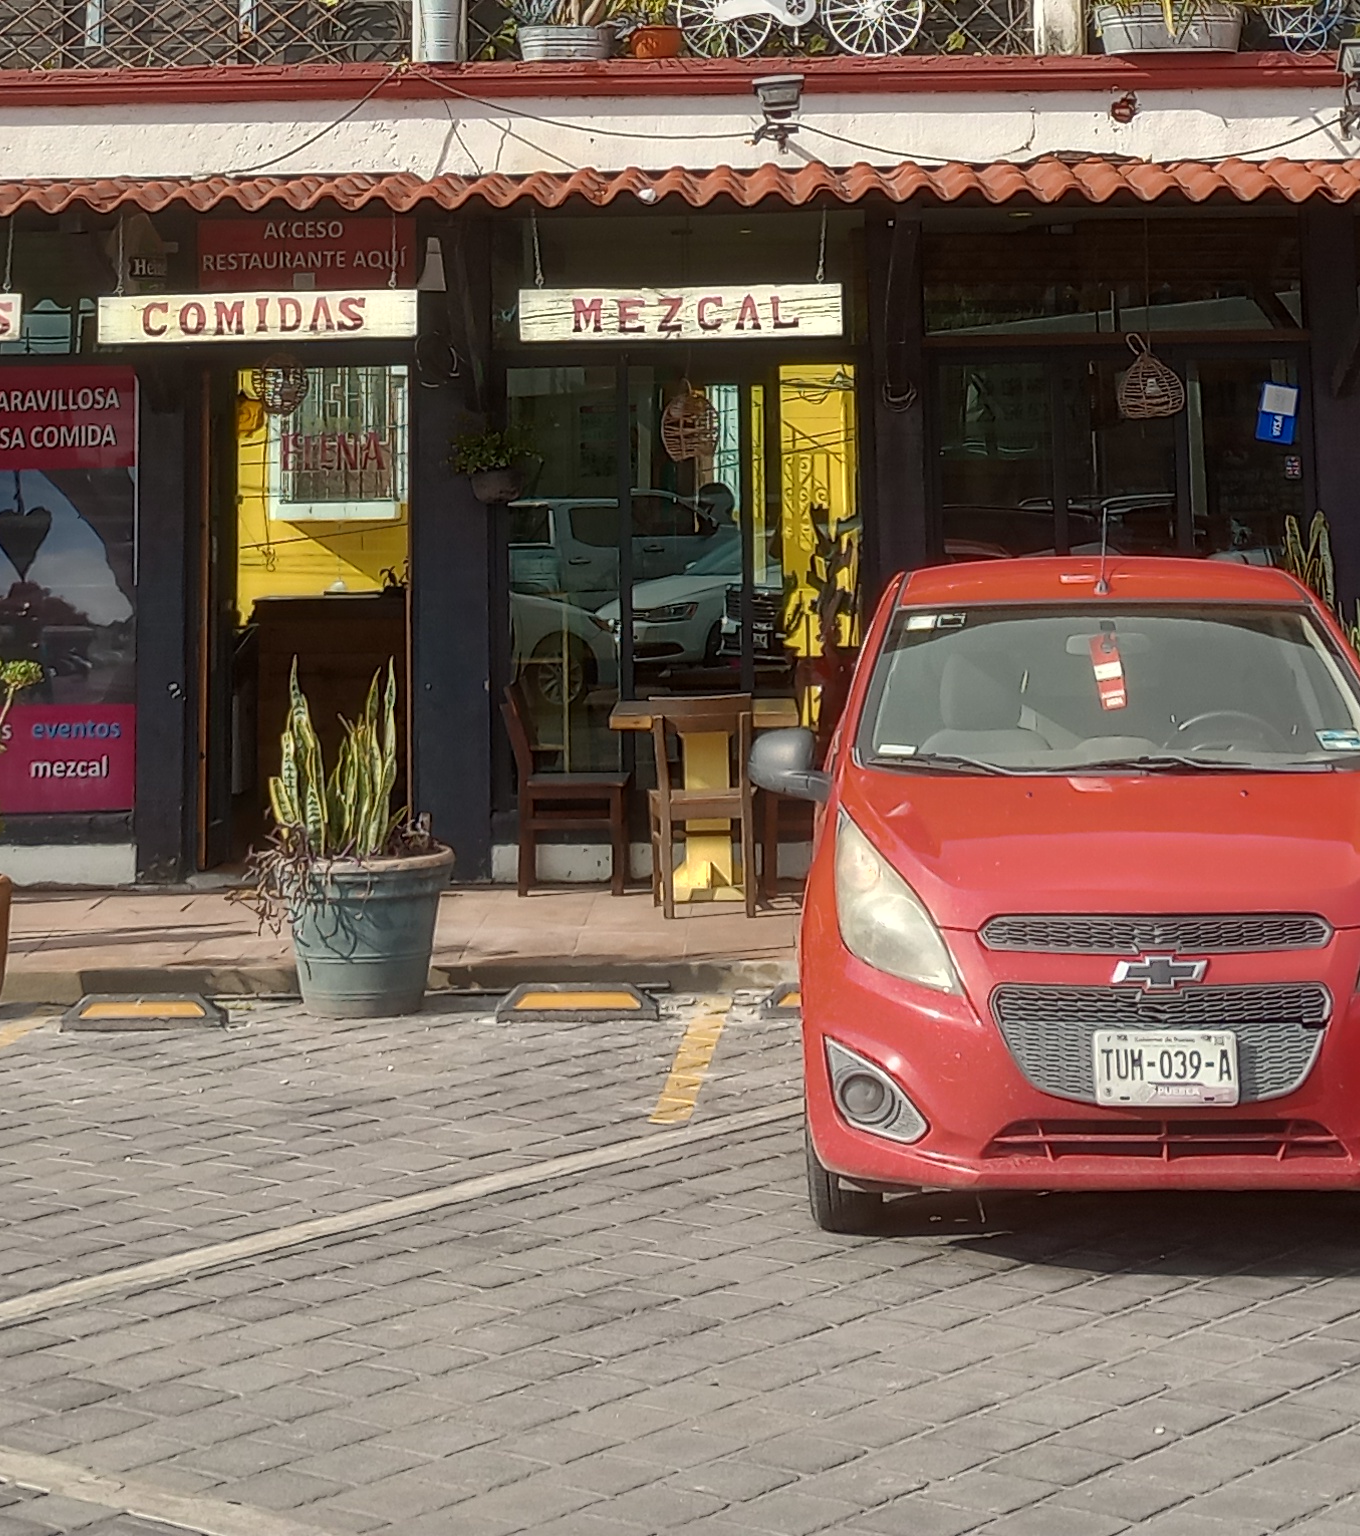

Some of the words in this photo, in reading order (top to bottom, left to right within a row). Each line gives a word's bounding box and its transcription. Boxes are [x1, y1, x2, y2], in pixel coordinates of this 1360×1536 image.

[263, 220, 344, 240] ACCESO
[202, 251, 346, 271] RESTAURANTE
[352, 245, 408, 269] AQUÍ
[142, 296, 366, 337] COMIDAS
[571, 293, 800, 333] MEZCAL
[29, 423, 117, 449] COMIDA
[1271, 414, 1285, 437] VISA
[31, 720, 121, 740] eventos
[29, 755, 108, 779] mezcal
[1101, 1048, 1232, 1081] TUM-039-A
